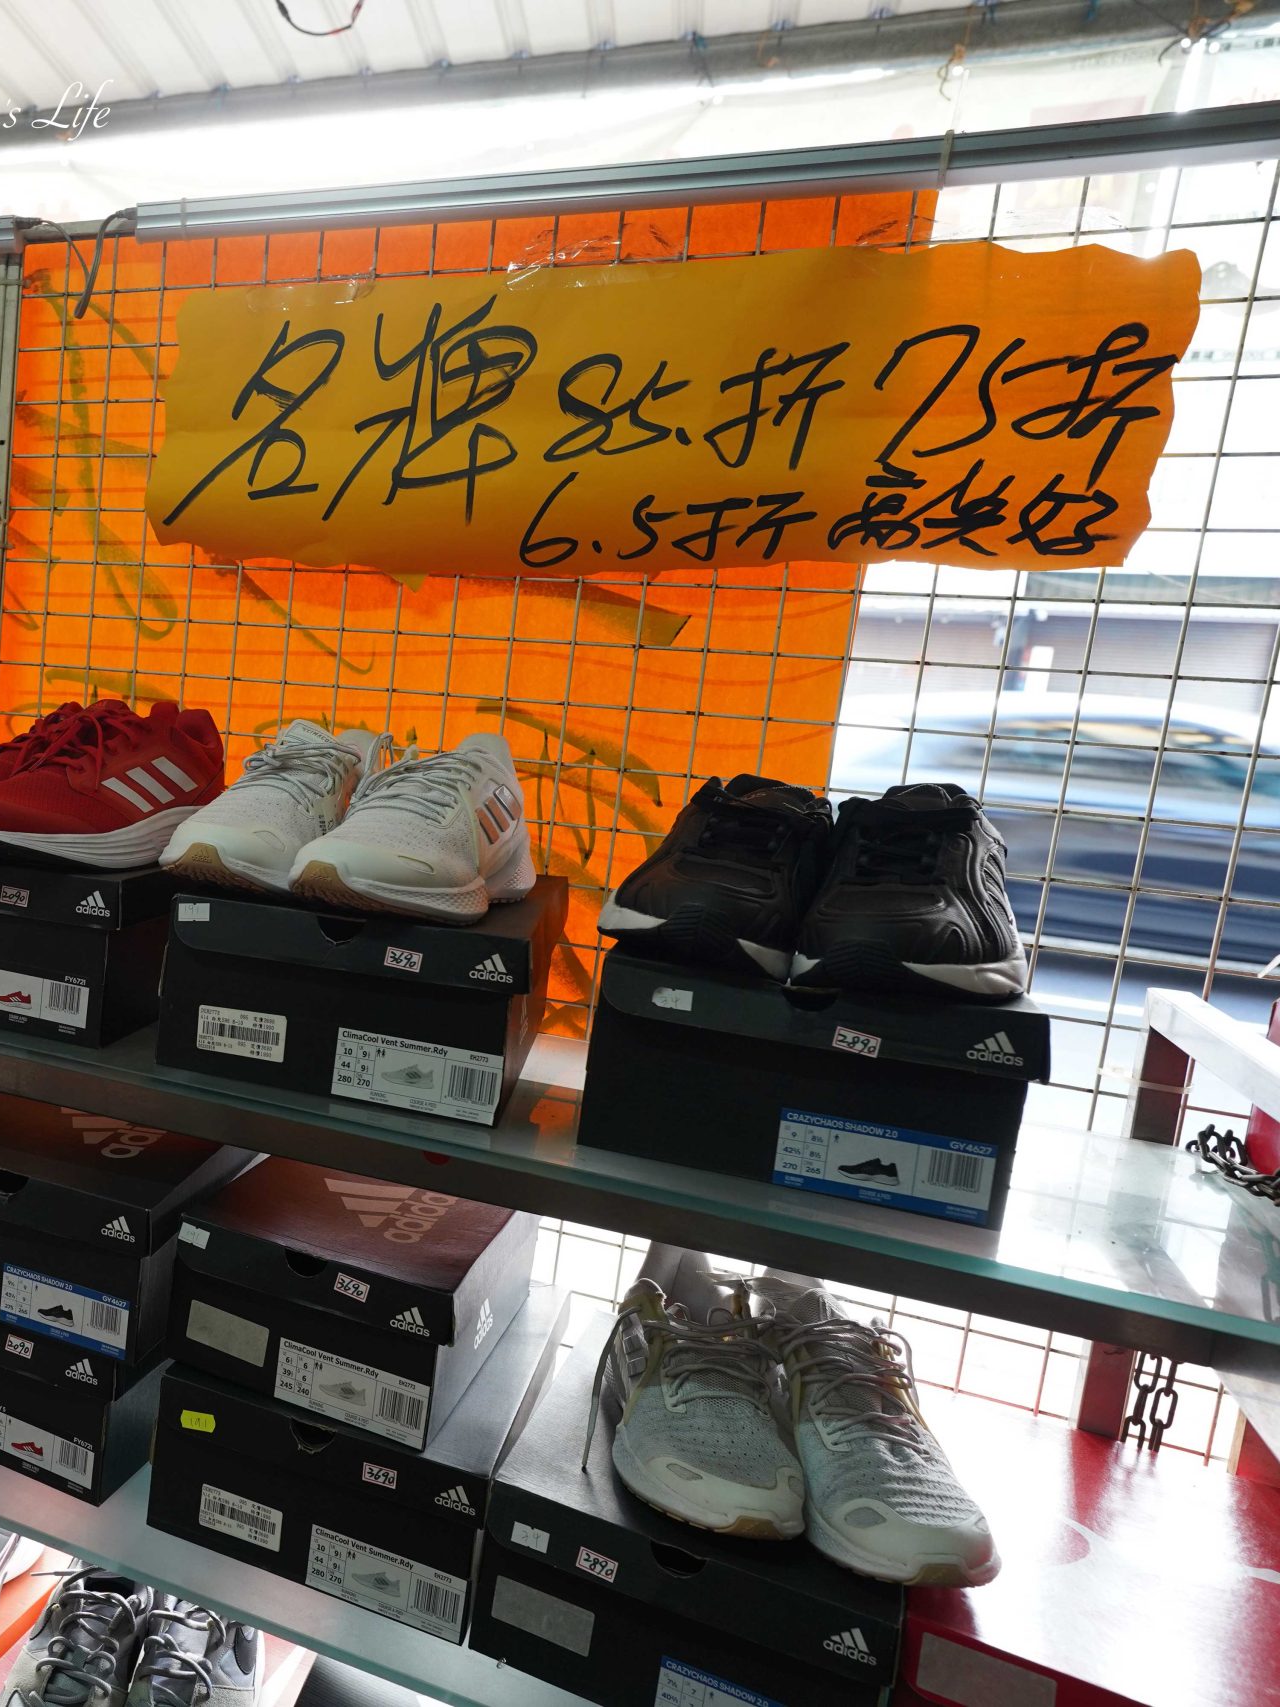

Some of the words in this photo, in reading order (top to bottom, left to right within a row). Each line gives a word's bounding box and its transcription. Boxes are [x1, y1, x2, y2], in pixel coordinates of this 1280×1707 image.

[1, 890, 26, 906] 2090
[76, 904, 110, 917] adidas
[389, 950, 417, 968] 3690
[64, 975, 87, 986] FY6721
[469, 968, 514, 984] adidas
[342, 1030, 379, 1045] ClimaCool
[380, 1038, 398, 1048] Vent
[399, 1040, 448, 1057] Summer.Rdy
[343, 1047, 353, 1056] 10
[836, 1031, 876, 1055] 2890
[340, 1060, 351, 1069] 44
[966, 1049, 1024, 1067] adidas
[337, 1074, 352, 1084] 280
[357, 1077, 370, 1088] 270
[787, 1112, 844, 1129] CRAZYCHAOS
[845, 1120, 883, 1136] SHADOW
[885, 1129, 898, 1139] 2.0
[950, 1141, 993, 1155] GY4627
[101, 1226, 135, 1242] adidas
[6, 1265, 40, 1282] CRAZYCHAOS
[41, 1273, 63, 1290] SHADOW
[337, 1277, 364, 1297] 3690
[390, 1317, 430, 1337] adidas
[474, 1313, 494, 1350] adidas
[8, 1339, 29, 1355] 2090
[283, 1341, 317, 1358] ClimaCool
[318, 1351, 334, 1363] Vent
[335, 1355, 379, 1379] Summer.Rdy
[65, 1369, 98, 1386] adidas
[280, 1380, 293, 1390] 245
[297, 1386, 310, 1396] 240
[365, 1466, 395, 1485] 3690
[434, 1495, 476, 1516] adidas
[315, 1527, 350, 1546] ClimaCool
[351, 1538, 367, 1553] Vent
[369, 1545, 414, 1571] Summer.Rdy
[316, 1543, 326, 1552] 10
[314, 1555, 324, 1564] 44
[583, 1552, 614, 1578] 2890
[311, 1567, 325, 1577] 280
[328, 1573, 342, 1585] 270
[823, 1639, 878, 1667] adidas
[666, 1660, 720, 1688] CRAZYCHAOS
[719, 1682, 756, 1704] SHADOW
